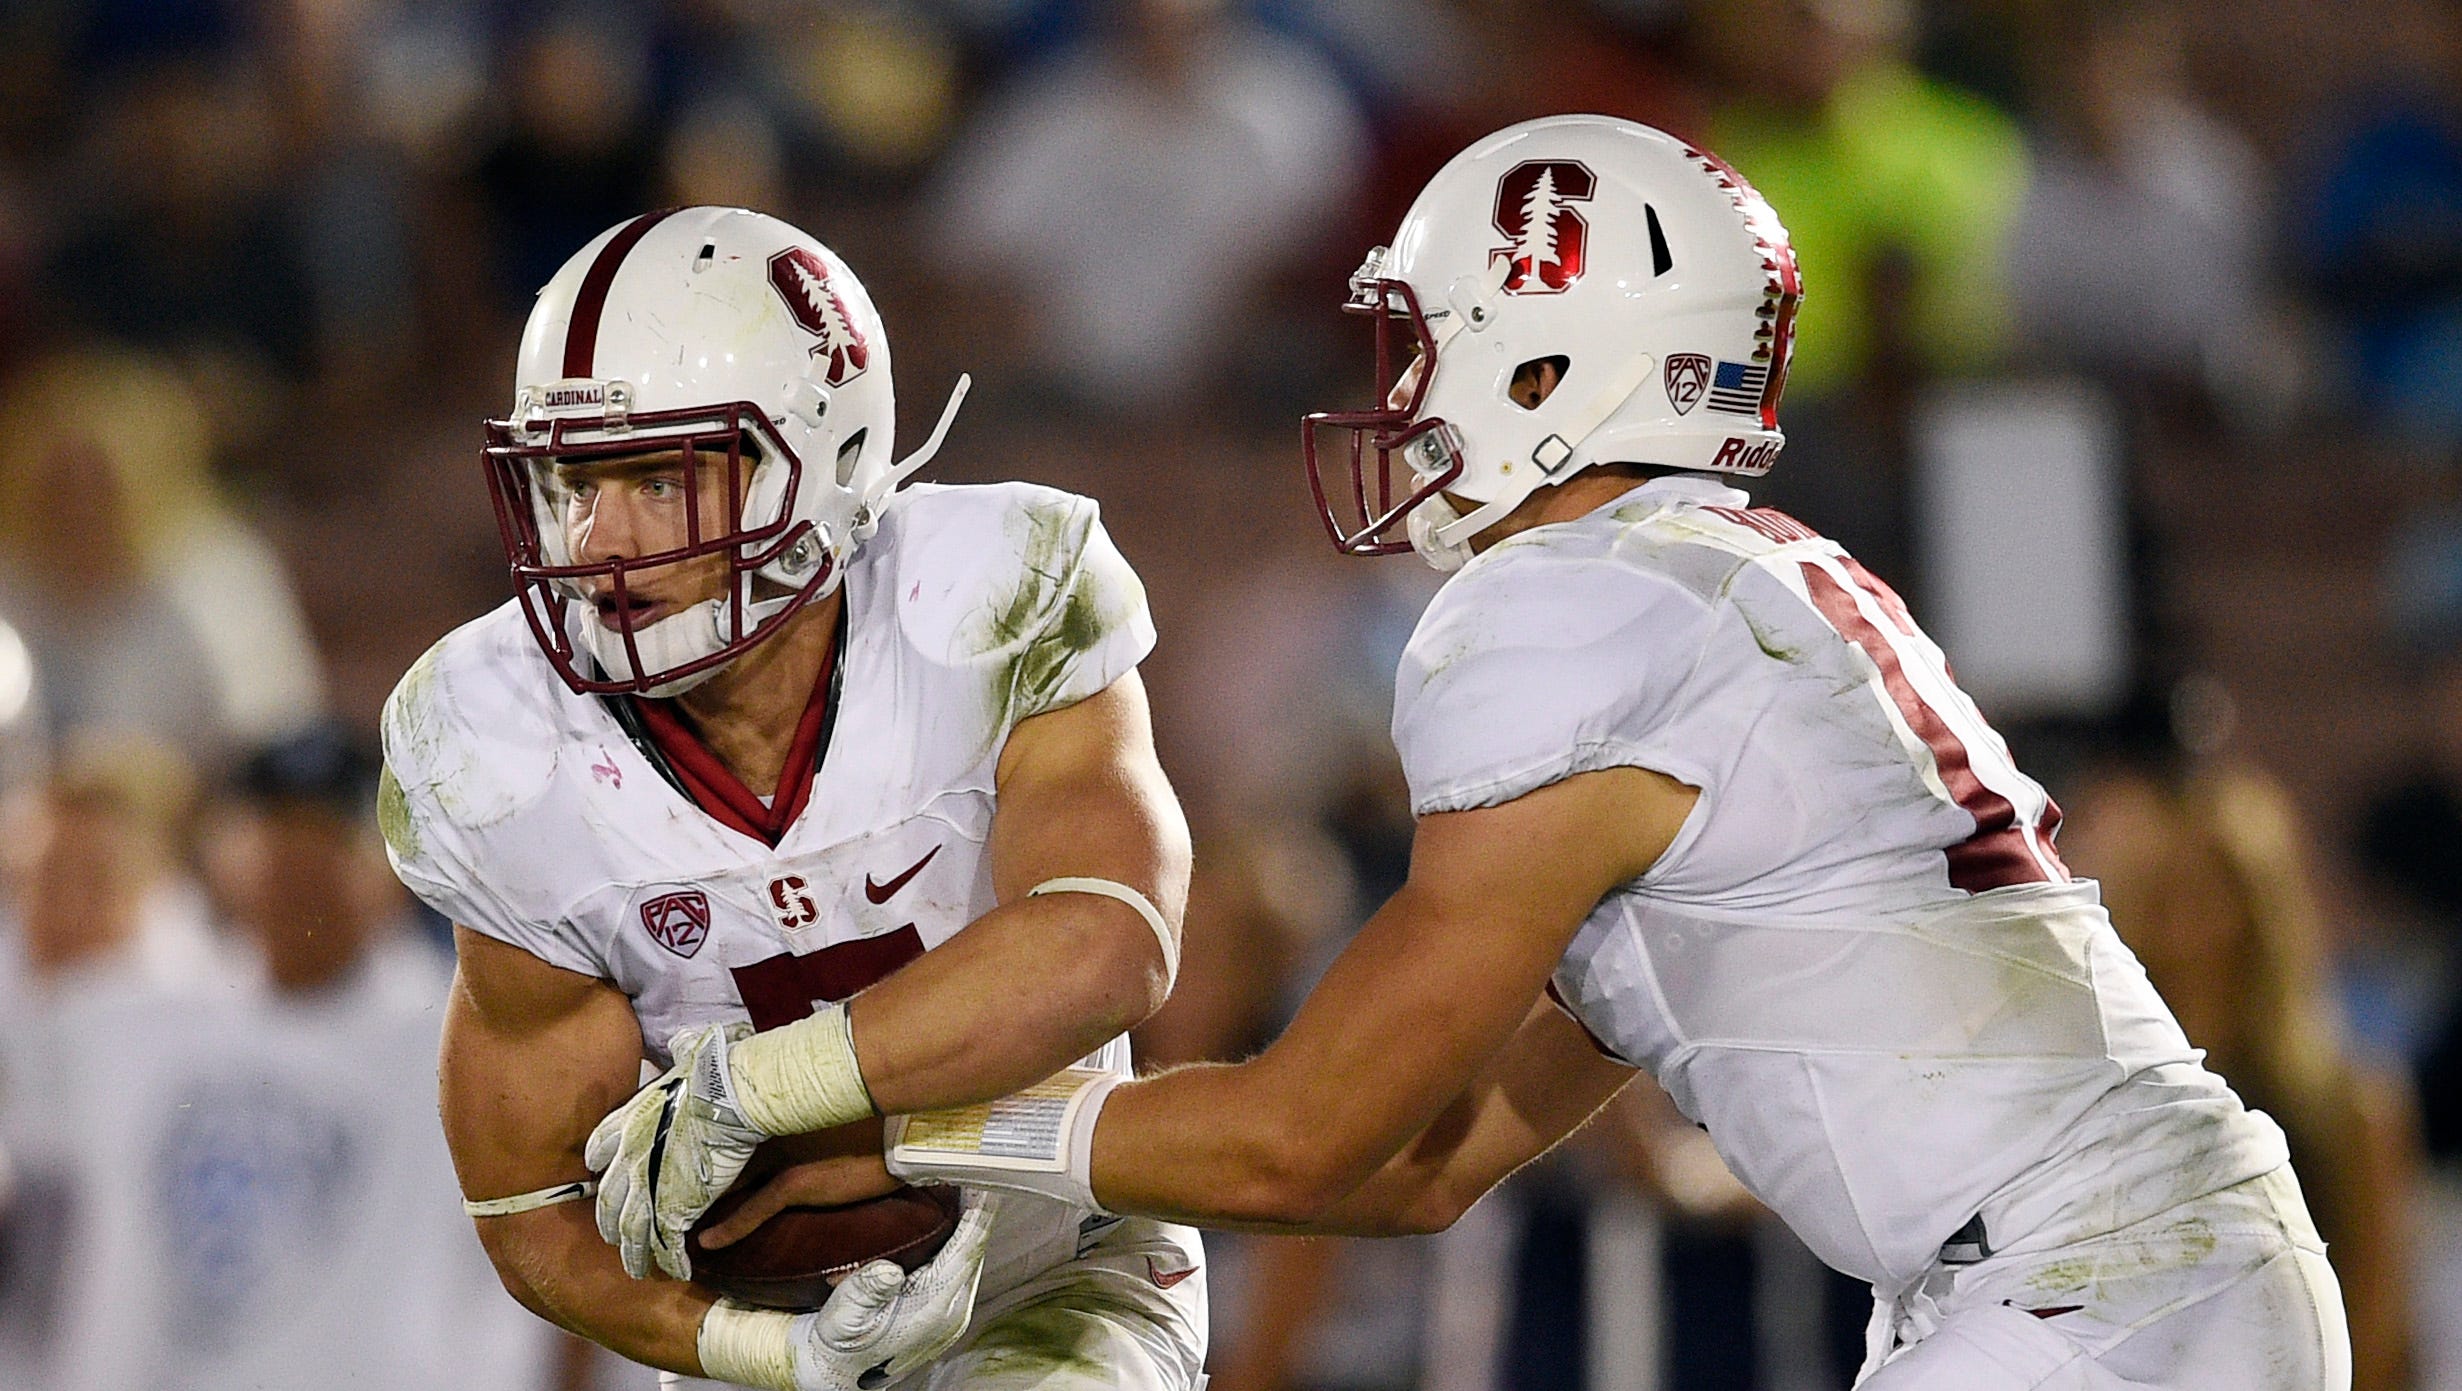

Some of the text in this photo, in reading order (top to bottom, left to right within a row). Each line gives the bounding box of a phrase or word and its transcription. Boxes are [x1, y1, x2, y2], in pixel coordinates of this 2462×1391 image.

[1667, 357, 1709, 390] PAC
[545, 389, 602, 407] CARDINAL
[1674, 381, 1697, 402] 12
[644, 895, 706, 938] PAC
[665, 921, 700, 948] 12
